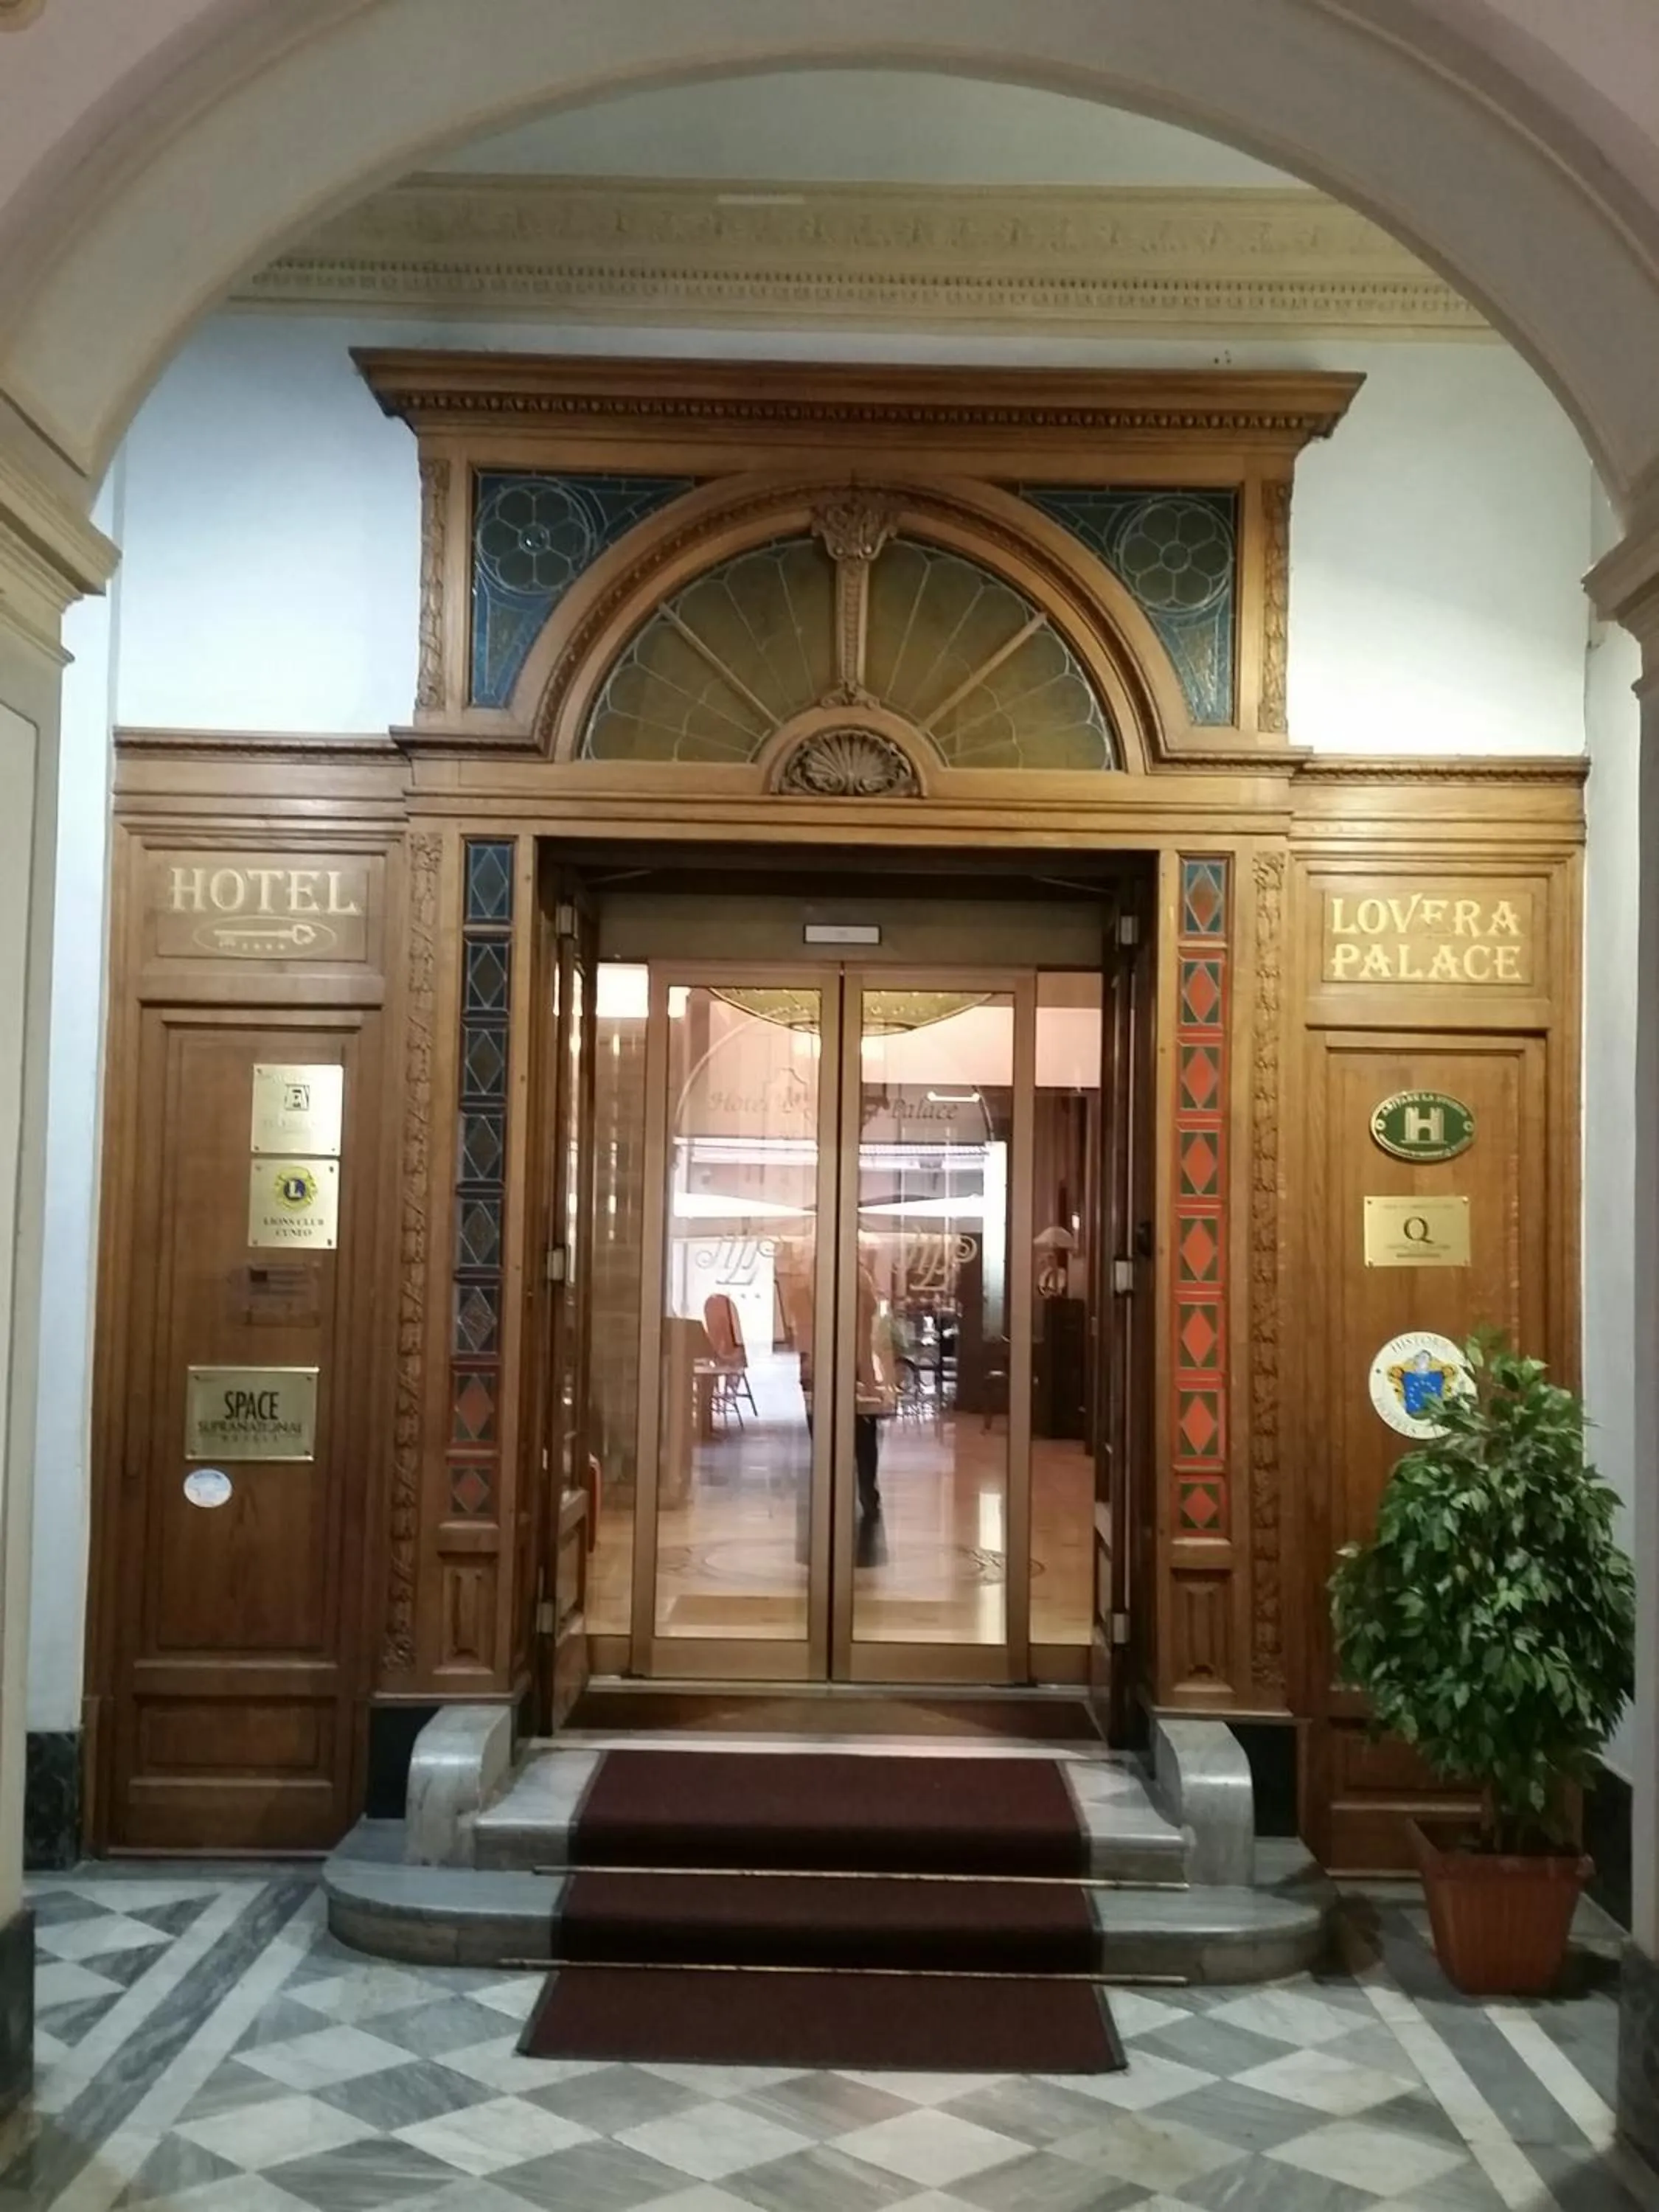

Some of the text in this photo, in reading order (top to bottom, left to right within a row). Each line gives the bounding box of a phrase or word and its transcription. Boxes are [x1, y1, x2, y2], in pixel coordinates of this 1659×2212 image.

[170, 868, 362, 914] HOTEL
[1332, 943, 1522, 980] PALACE
[1403, 1217, 1434, 1245] Q
[224, 1391, 279, 1420] SPACE
